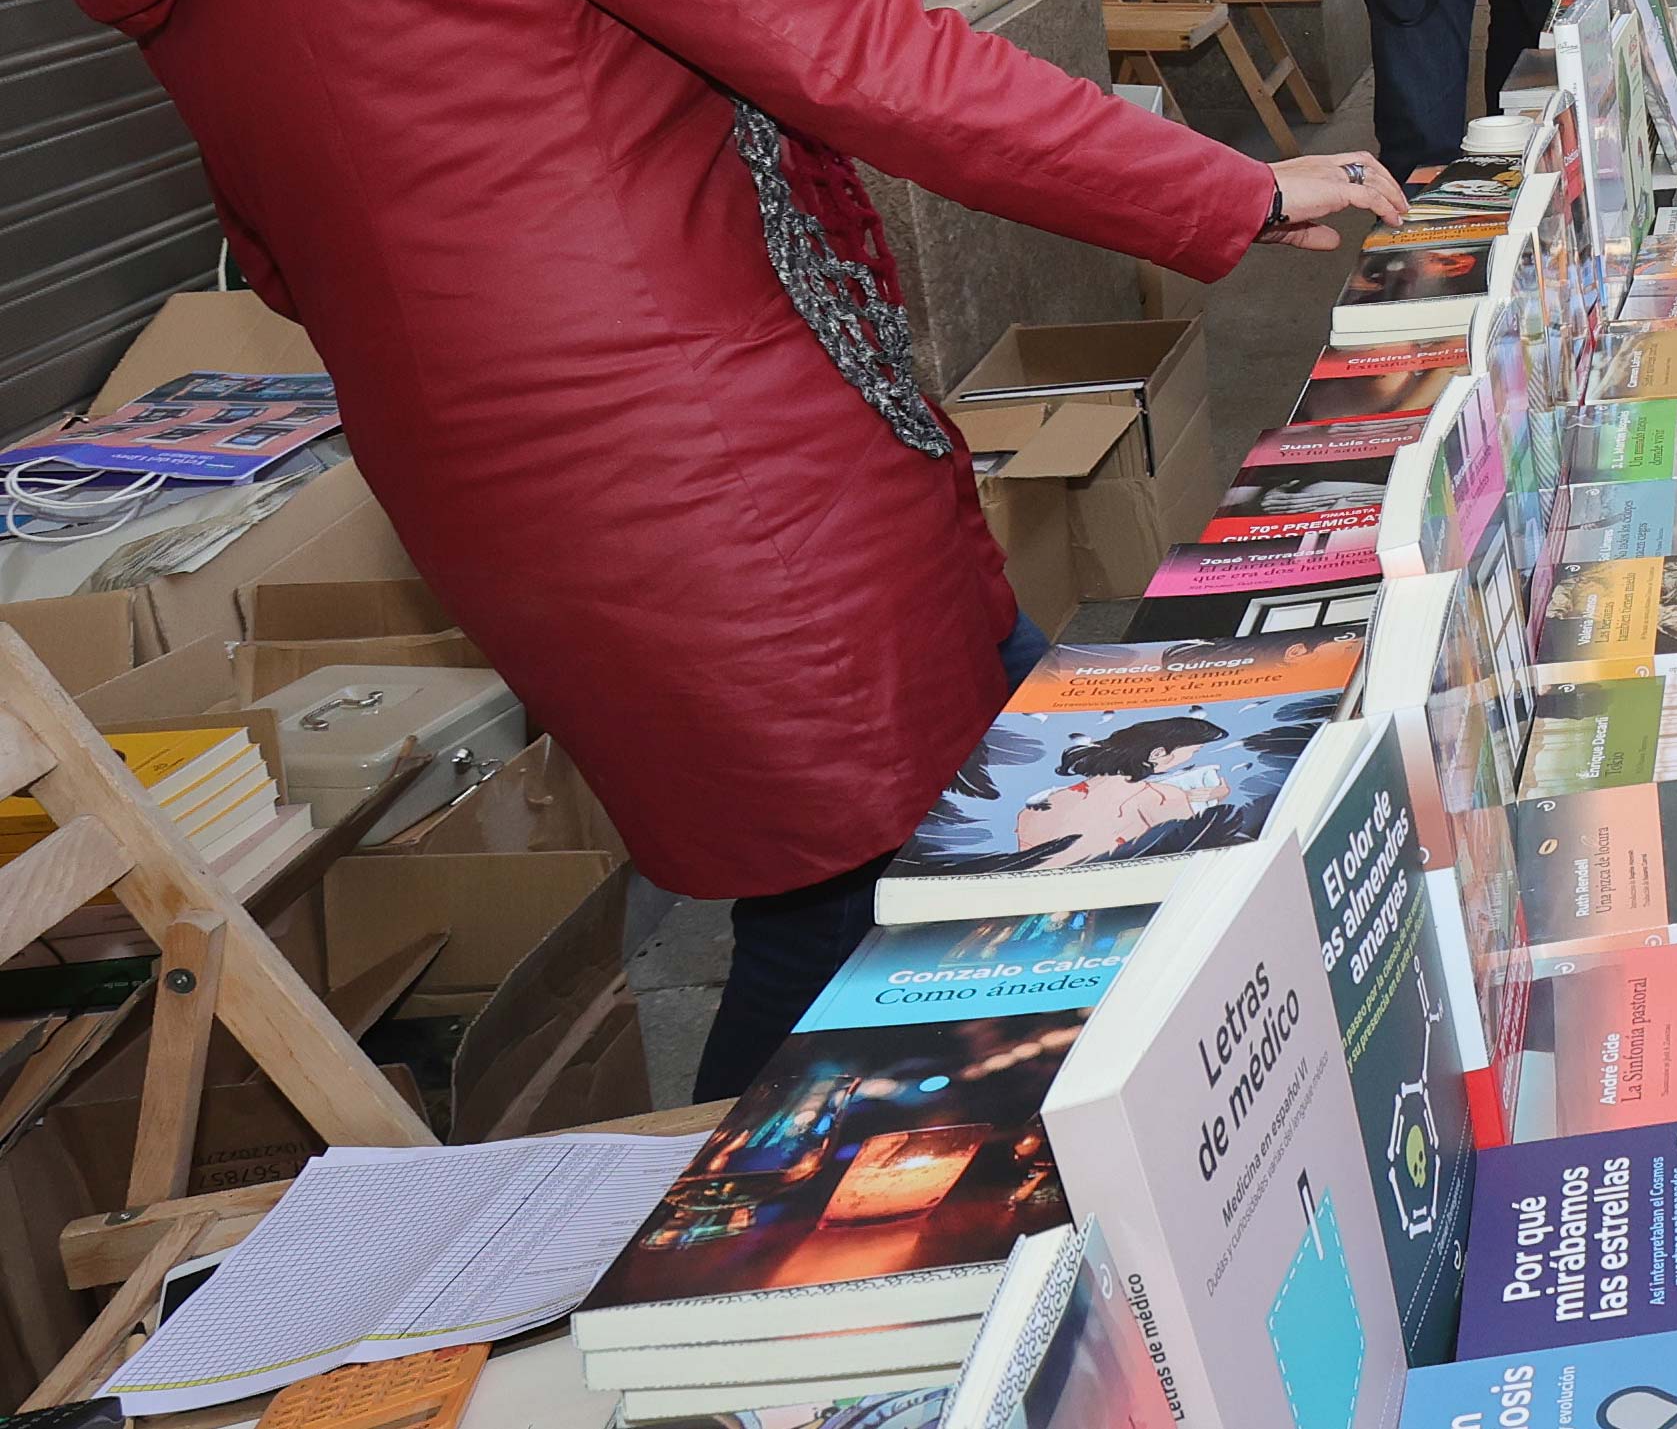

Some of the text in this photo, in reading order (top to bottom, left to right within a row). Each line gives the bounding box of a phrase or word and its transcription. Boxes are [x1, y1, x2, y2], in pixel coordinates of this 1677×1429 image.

[1348, 349, 1450, 366] Cristina Peri
[1279, 434, 1414, 452] Juan Luis Cano
[1282, 516, 1359, 533] PREMIO
[1319, 508, 1376, 519] FINALISTA
[1192, 557, 1377, 584] que era dos hombres
[1199, 548, 1326, 566] José Terradas
[1060, 672, 1285, 698] de locura de muerte
[1068, 667, 1246, 688] Cuentos de amor
[1074, 655, 1255, 677] Horacio Quiroga
[1586, 745, 1604, 779] Enrique
[1321, 789, 1393, 910] El olor de
[1342, 807, 1411, 940] almendras
[1596, 826, 1617, 914] Una pizca locura
[1575, 858, 1591, 917] Ruth Rendell
[1348, 868, 1408, 985] amargas
[873, 973, 1101, 1006] Como ánades
[887, 963, 1024, 986] Gonzalo
[1632, 977, 1652, 1024] pastoral
[1198, 960, 1271, 1090] Letras
[1198, 987, 1301, 1183] de médico
[1599, 1032, 1621, 1106] André Gide
[1221, 1081, 1301, 1229] Medicina español
[1511, 1195, 1555, 1248] qué
[1545, 1165, 1590, 1323] mirábamos
[1589, 1156, 1631, 1321] las estrellas
[1649, 1156, 1667, 1306] Así interpretaban Cosmos
[1205, 1256, 1229, 1298] Dudas
[1502, 1252, 1543, 1303] Por
[1127, 1273, 1159, 1338] médico
[1556, 1365, 1576, 1423] evolución
